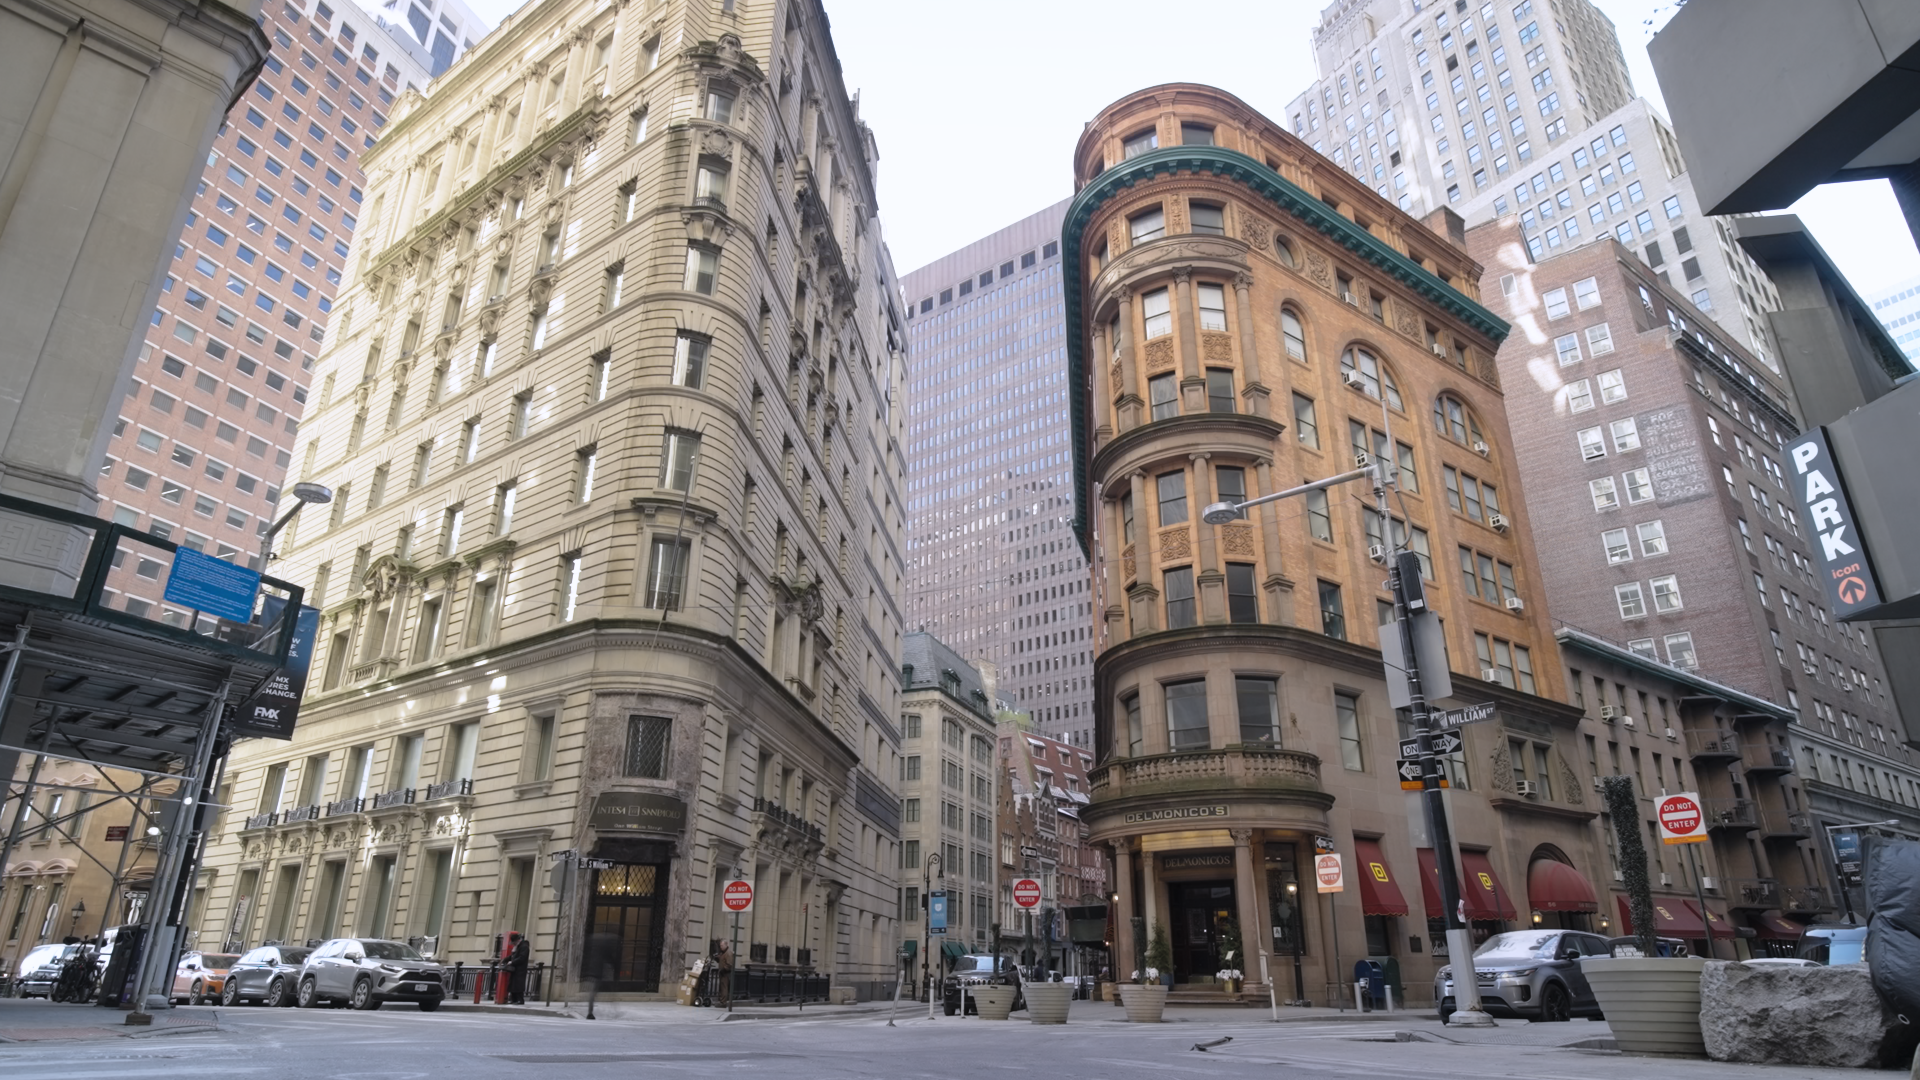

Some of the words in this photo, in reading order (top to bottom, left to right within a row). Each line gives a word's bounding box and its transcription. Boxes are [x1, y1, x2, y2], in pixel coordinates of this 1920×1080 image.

[1791, 441, 1856, 562] PARK
[1831, 563, 1860, 580] icon
[254, 706, 281, 720] FMX
[1448, 709, 1487, 725] WILLIAM
[1405, 744, 1418, 755] ON
[1432, 738, 1453, 750] WAY
[1405, 766, 1420, 775] ONE
[597, 806, 626, 815] INTESA
[641, 807, 681, 819] SANPAOLO
[1126, 806, 1225, 823] DELMONICO'S
[1663, 804, 1675, 812] DO
[1676, 802, 1692, 810] NOT
[1668, 820, 1696, 829] ENTER
